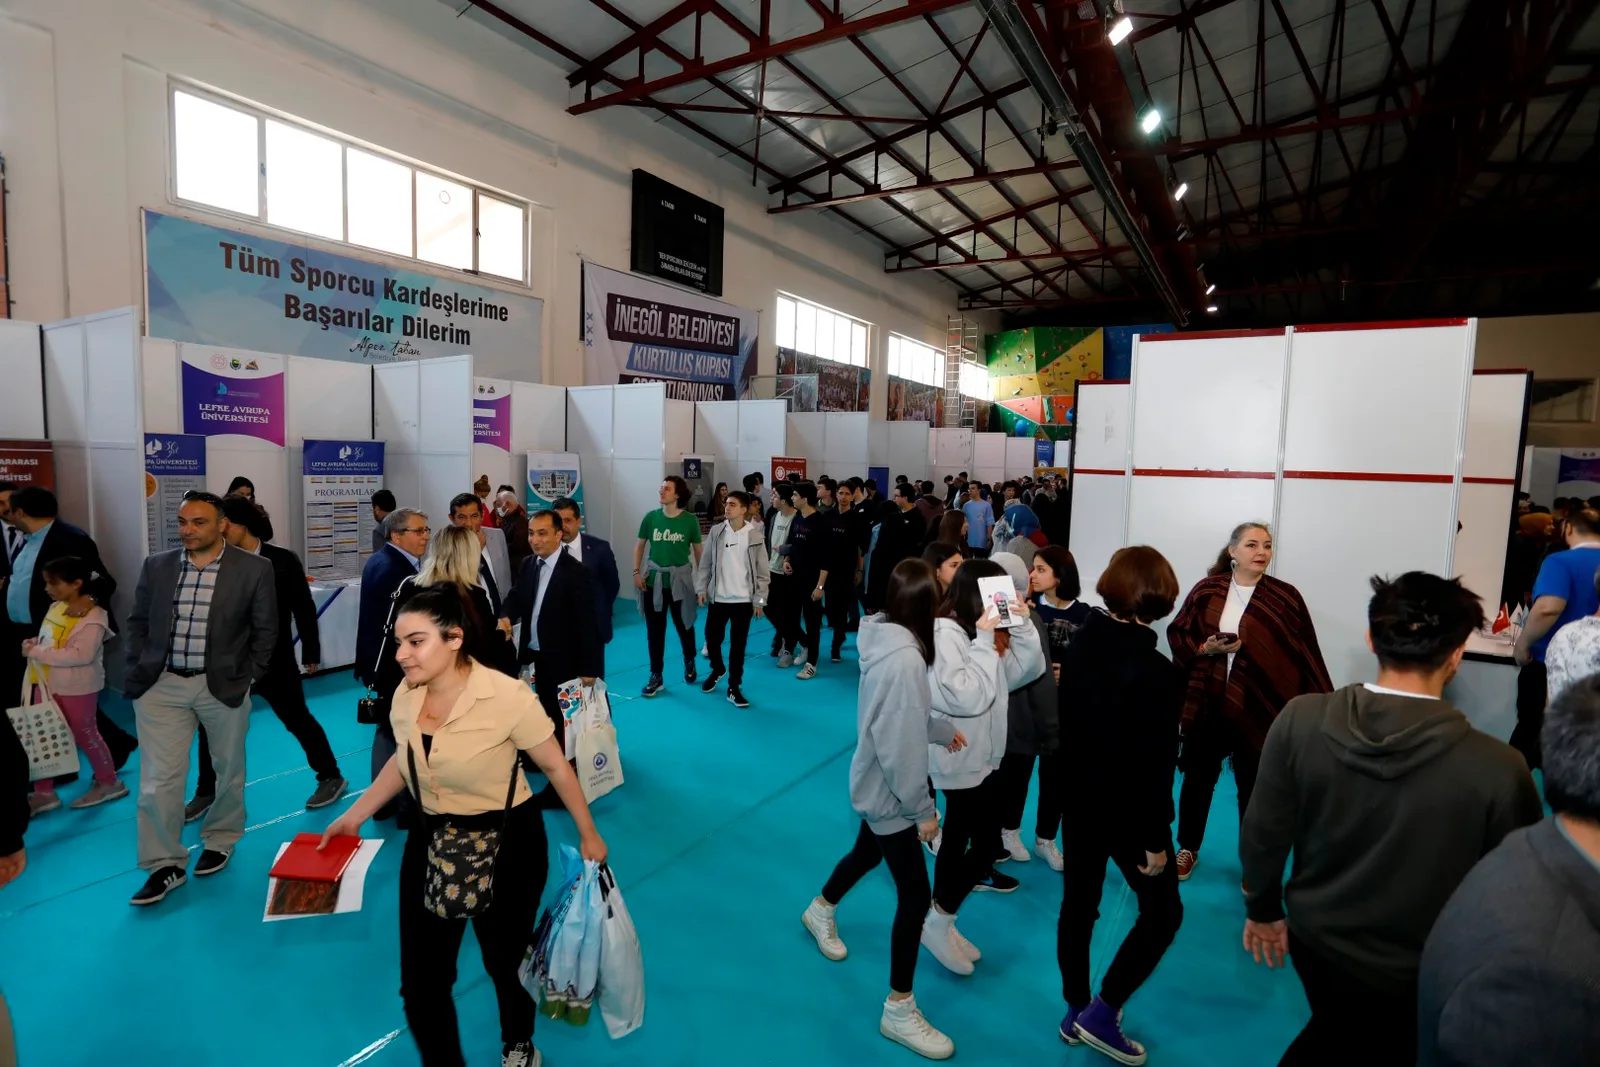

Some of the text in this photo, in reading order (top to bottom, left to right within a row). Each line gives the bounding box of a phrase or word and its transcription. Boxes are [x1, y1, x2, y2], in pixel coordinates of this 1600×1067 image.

[219, 241, 509, 322] Tüm Sporcu Kardeşlerime
[284, 293, 471, 346] Başarılar Dilerim
[613, 297, 736, 347] İNEGÖL BELEDİYESİ
[632, 345, 731, 379] KURTULUŞ KUPASI
[666, 381, 724, 401] TURNUVASI
[199, 403, 270, 415] LEFKE AVRUPA
[201, 411, 269, 424] ÜNİVERSİTESİ
[314, 488, 375, 497] PROGRAMLAR
[663, 528, 685, 544] Cooper
